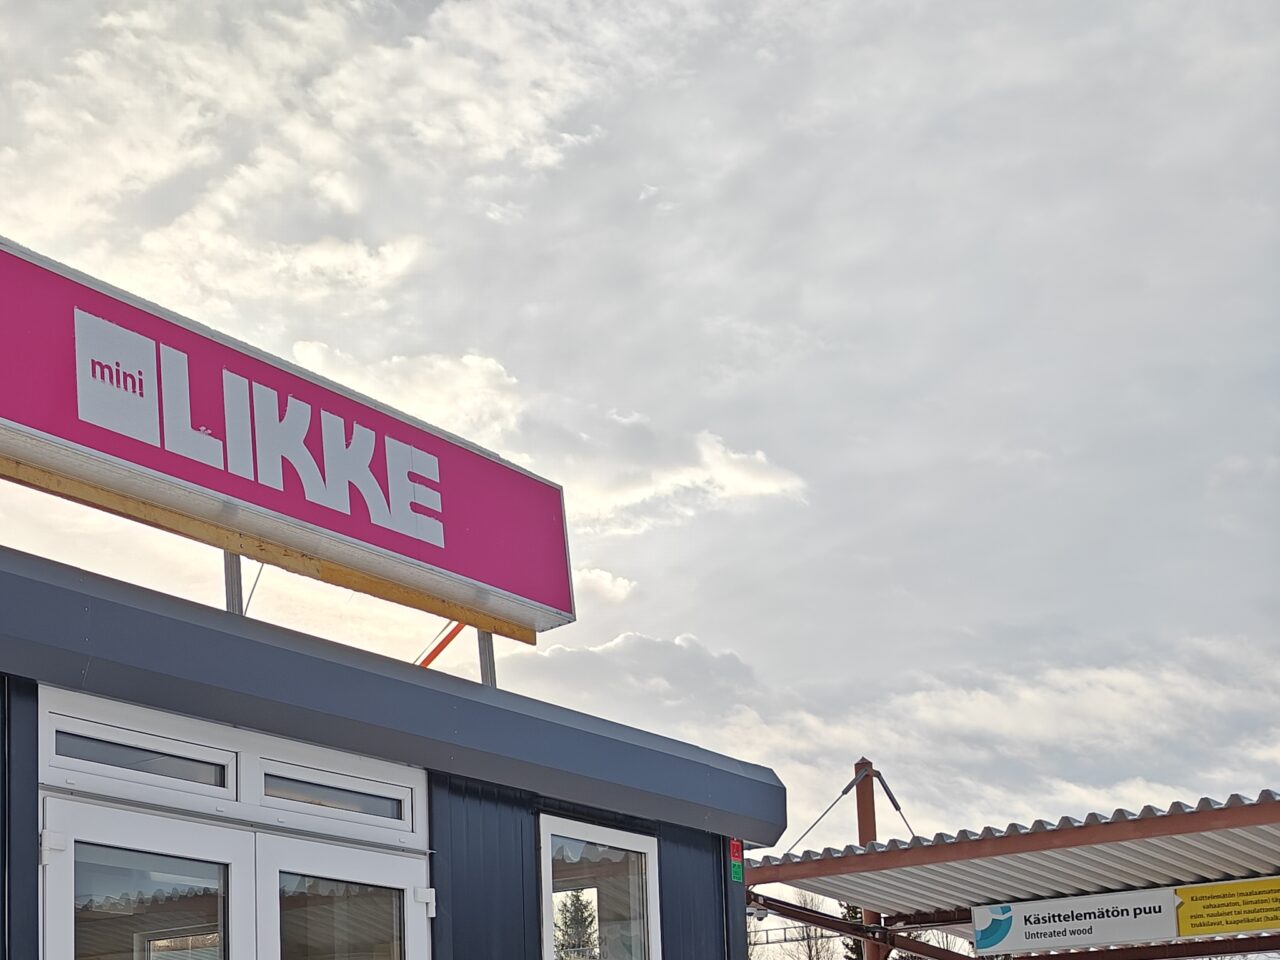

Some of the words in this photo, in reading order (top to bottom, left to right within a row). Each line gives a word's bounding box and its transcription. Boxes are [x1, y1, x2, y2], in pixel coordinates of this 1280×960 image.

[91, 357, 144, 398] mini
[160, 342, 445, 549] LIKKE
[1023, 906, 1130, 926] Käsittelemätön
[1133, 904, 1163, 919] puu
[1024, 927, 1067, 940] Untreated
[1069, 925, 1093, 936] wood
